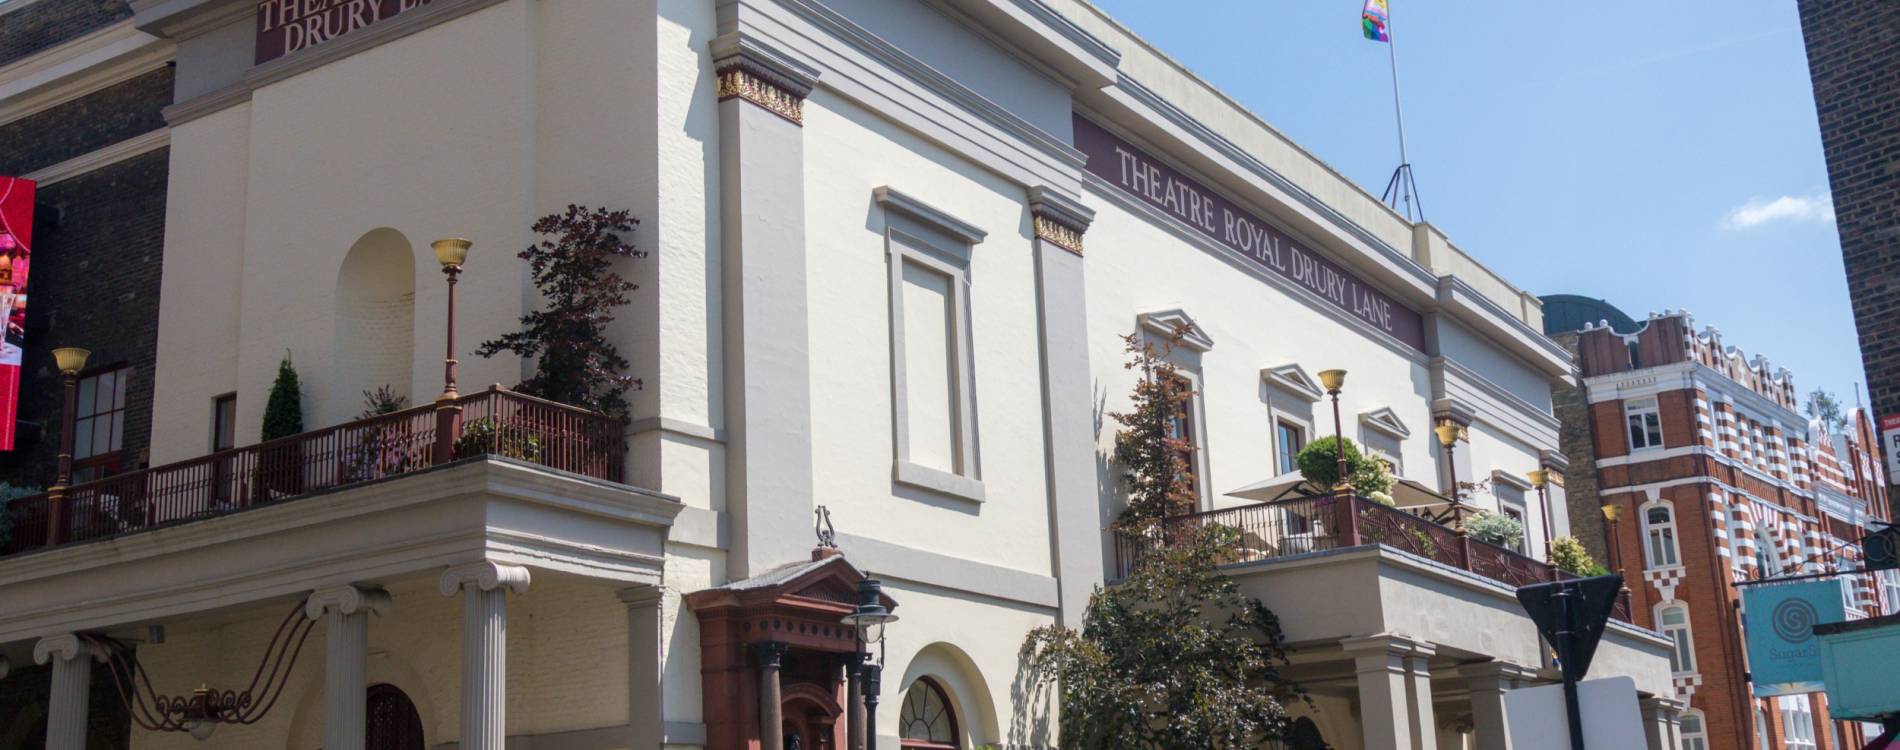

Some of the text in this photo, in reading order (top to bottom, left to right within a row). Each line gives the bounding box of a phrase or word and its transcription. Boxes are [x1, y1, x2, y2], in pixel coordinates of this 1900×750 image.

[282, 0, 383, 57] DRURY
[1115, 145, 1393, 332] THEATRE ROYAL DRURY LANE
[1770, 644, 1820, 660] SugarS
